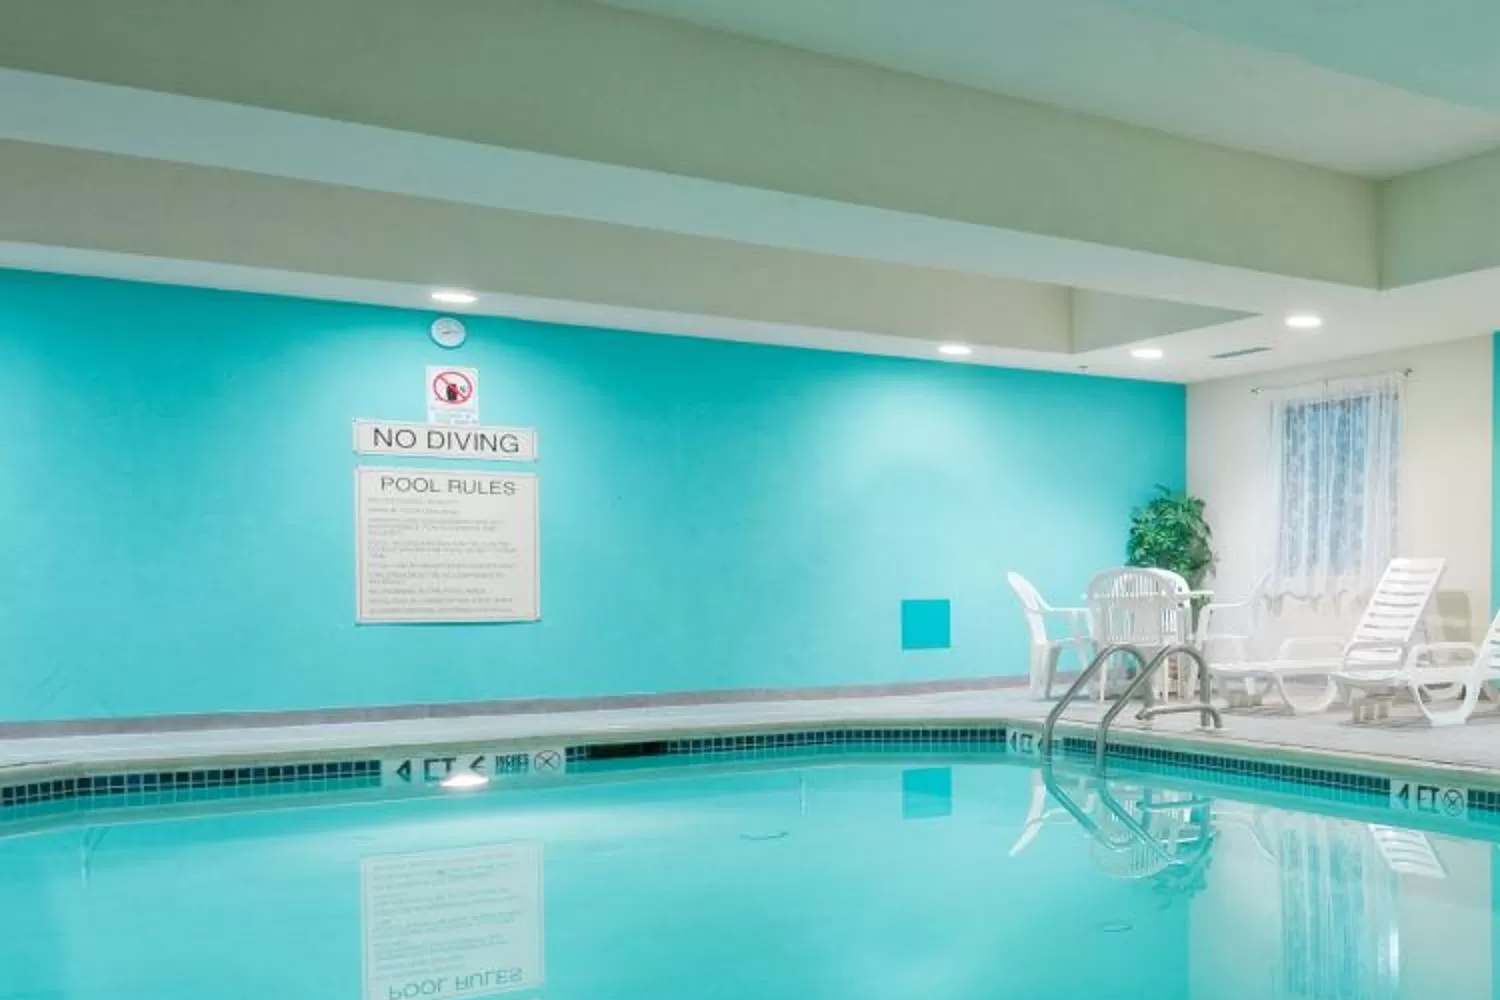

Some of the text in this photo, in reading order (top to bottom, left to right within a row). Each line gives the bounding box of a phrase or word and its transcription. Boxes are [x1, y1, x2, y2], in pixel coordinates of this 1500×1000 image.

[373, 427, 520, 453] NO DIVING
[380, 475, 517, 496] POOL RULES
